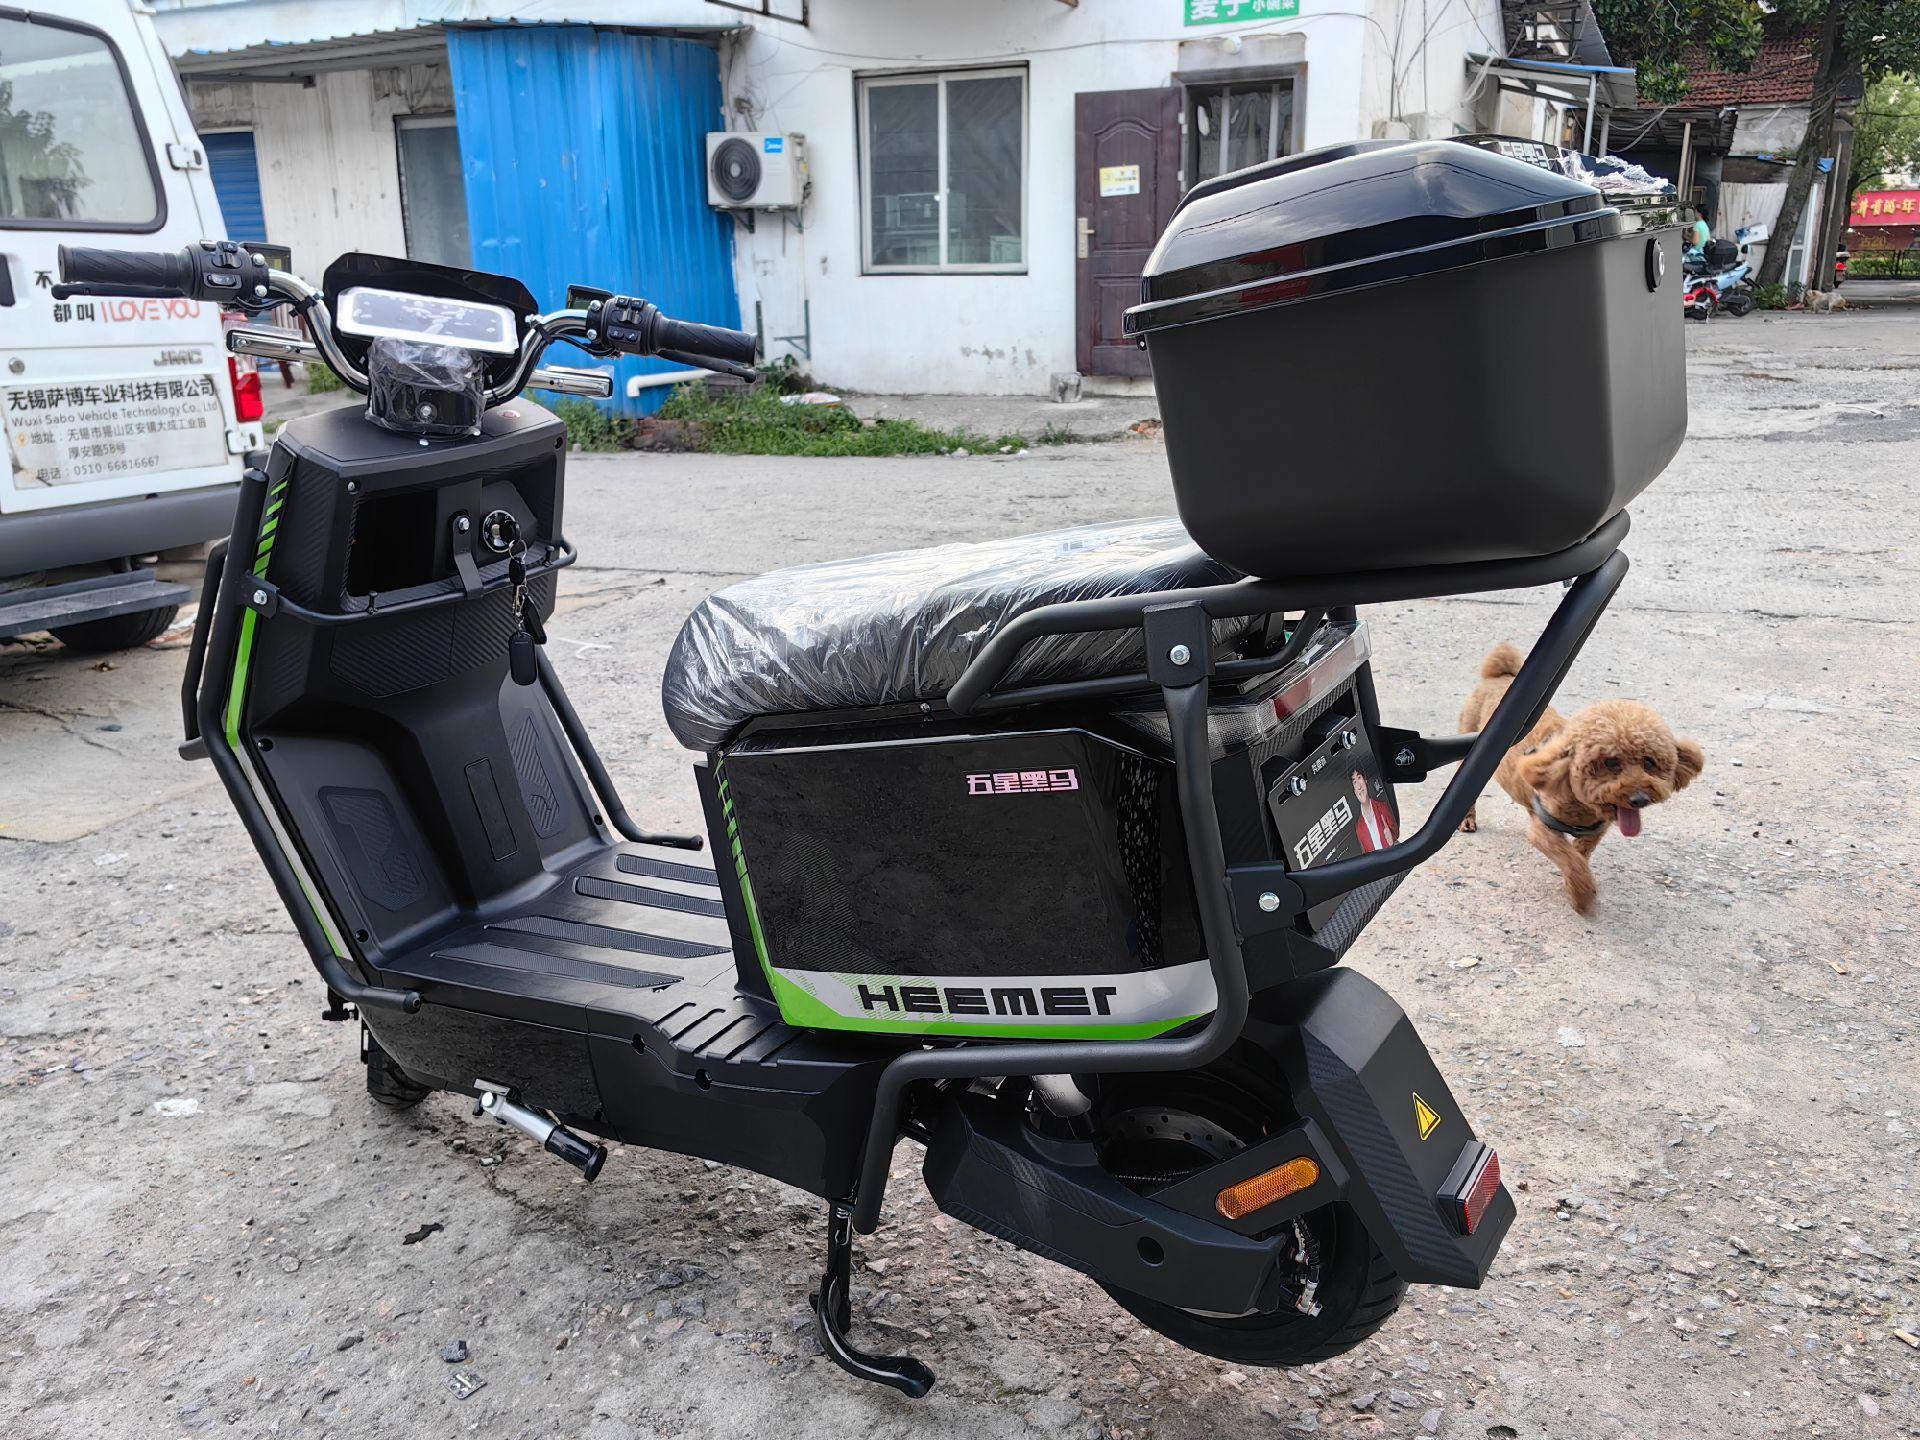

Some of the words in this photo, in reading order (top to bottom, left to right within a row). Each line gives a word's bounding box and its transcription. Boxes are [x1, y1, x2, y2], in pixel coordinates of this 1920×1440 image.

[53, 303, 95, 323] 都叫
[109, 300, 161, 322] LOVE
[160, 298, 200, 320] YOU
[8, 378, 216, 411] 无锡萨博车业科技有限公司
[12, 414, 43, 428] Wuxi
[45, 411, 75, 424] Sabo
[77, 408, 118, 422] Vehicle
[121, 402, 181, 419] Technology
[966, 768, 1079, 795] 五星黑马
[1293, 795, 1353, 871] 五星黑马
